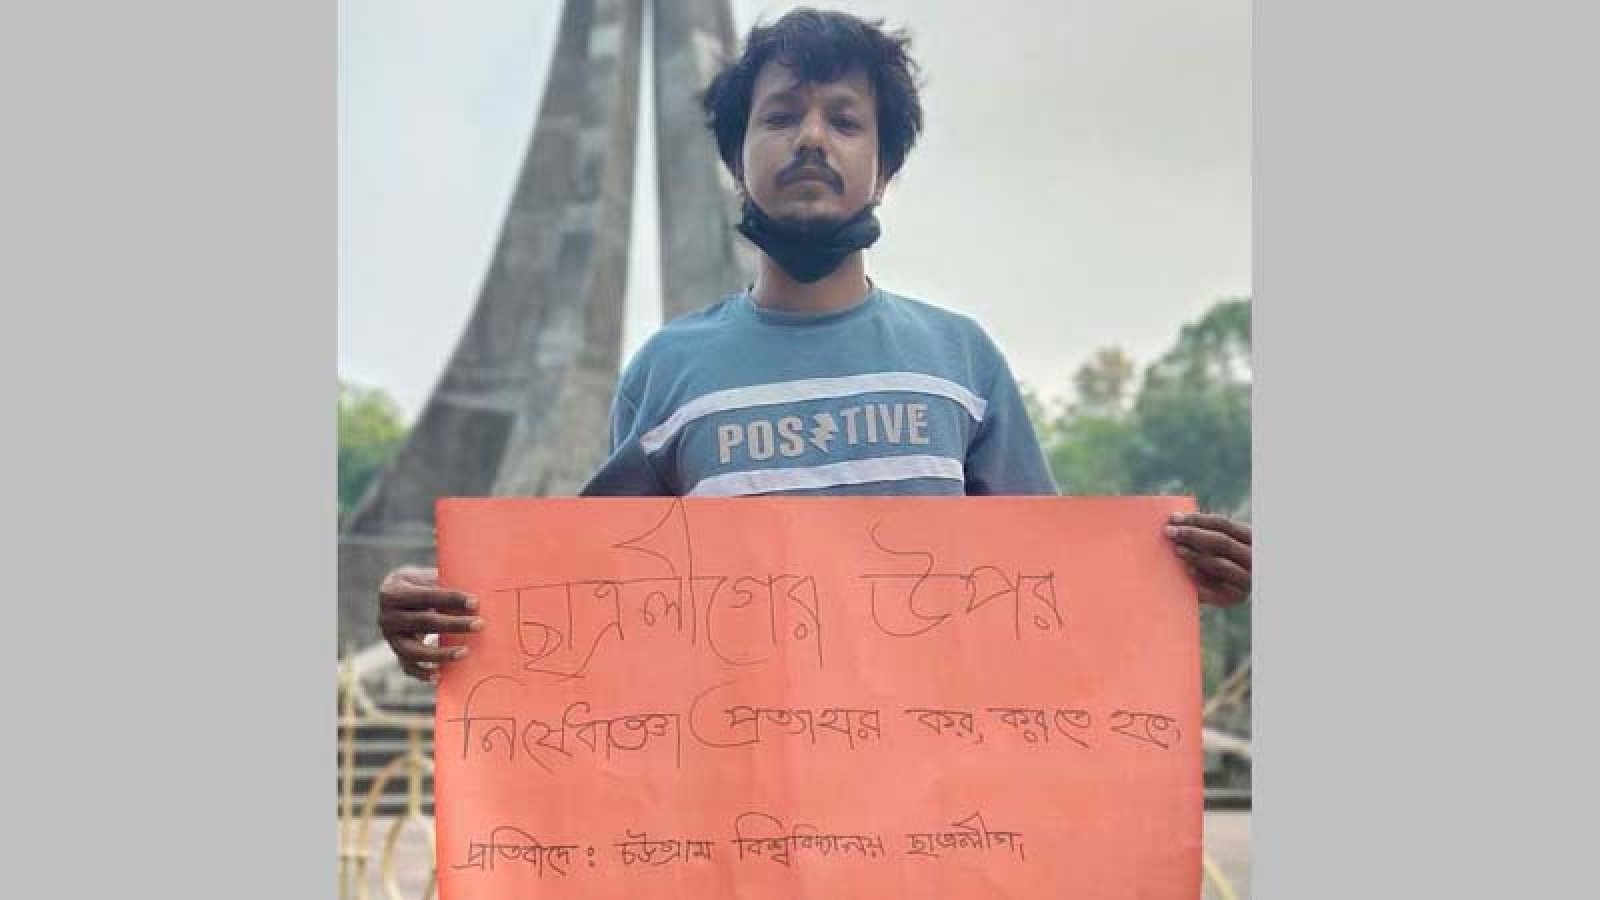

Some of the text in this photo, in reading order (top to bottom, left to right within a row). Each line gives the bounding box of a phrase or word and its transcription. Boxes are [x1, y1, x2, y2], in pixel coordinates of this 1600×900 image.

[494, 496, 1063, 678] ছাত্রলীগের উপর
[447, 675, 681, 774] নিষেধাজ্ঞা
